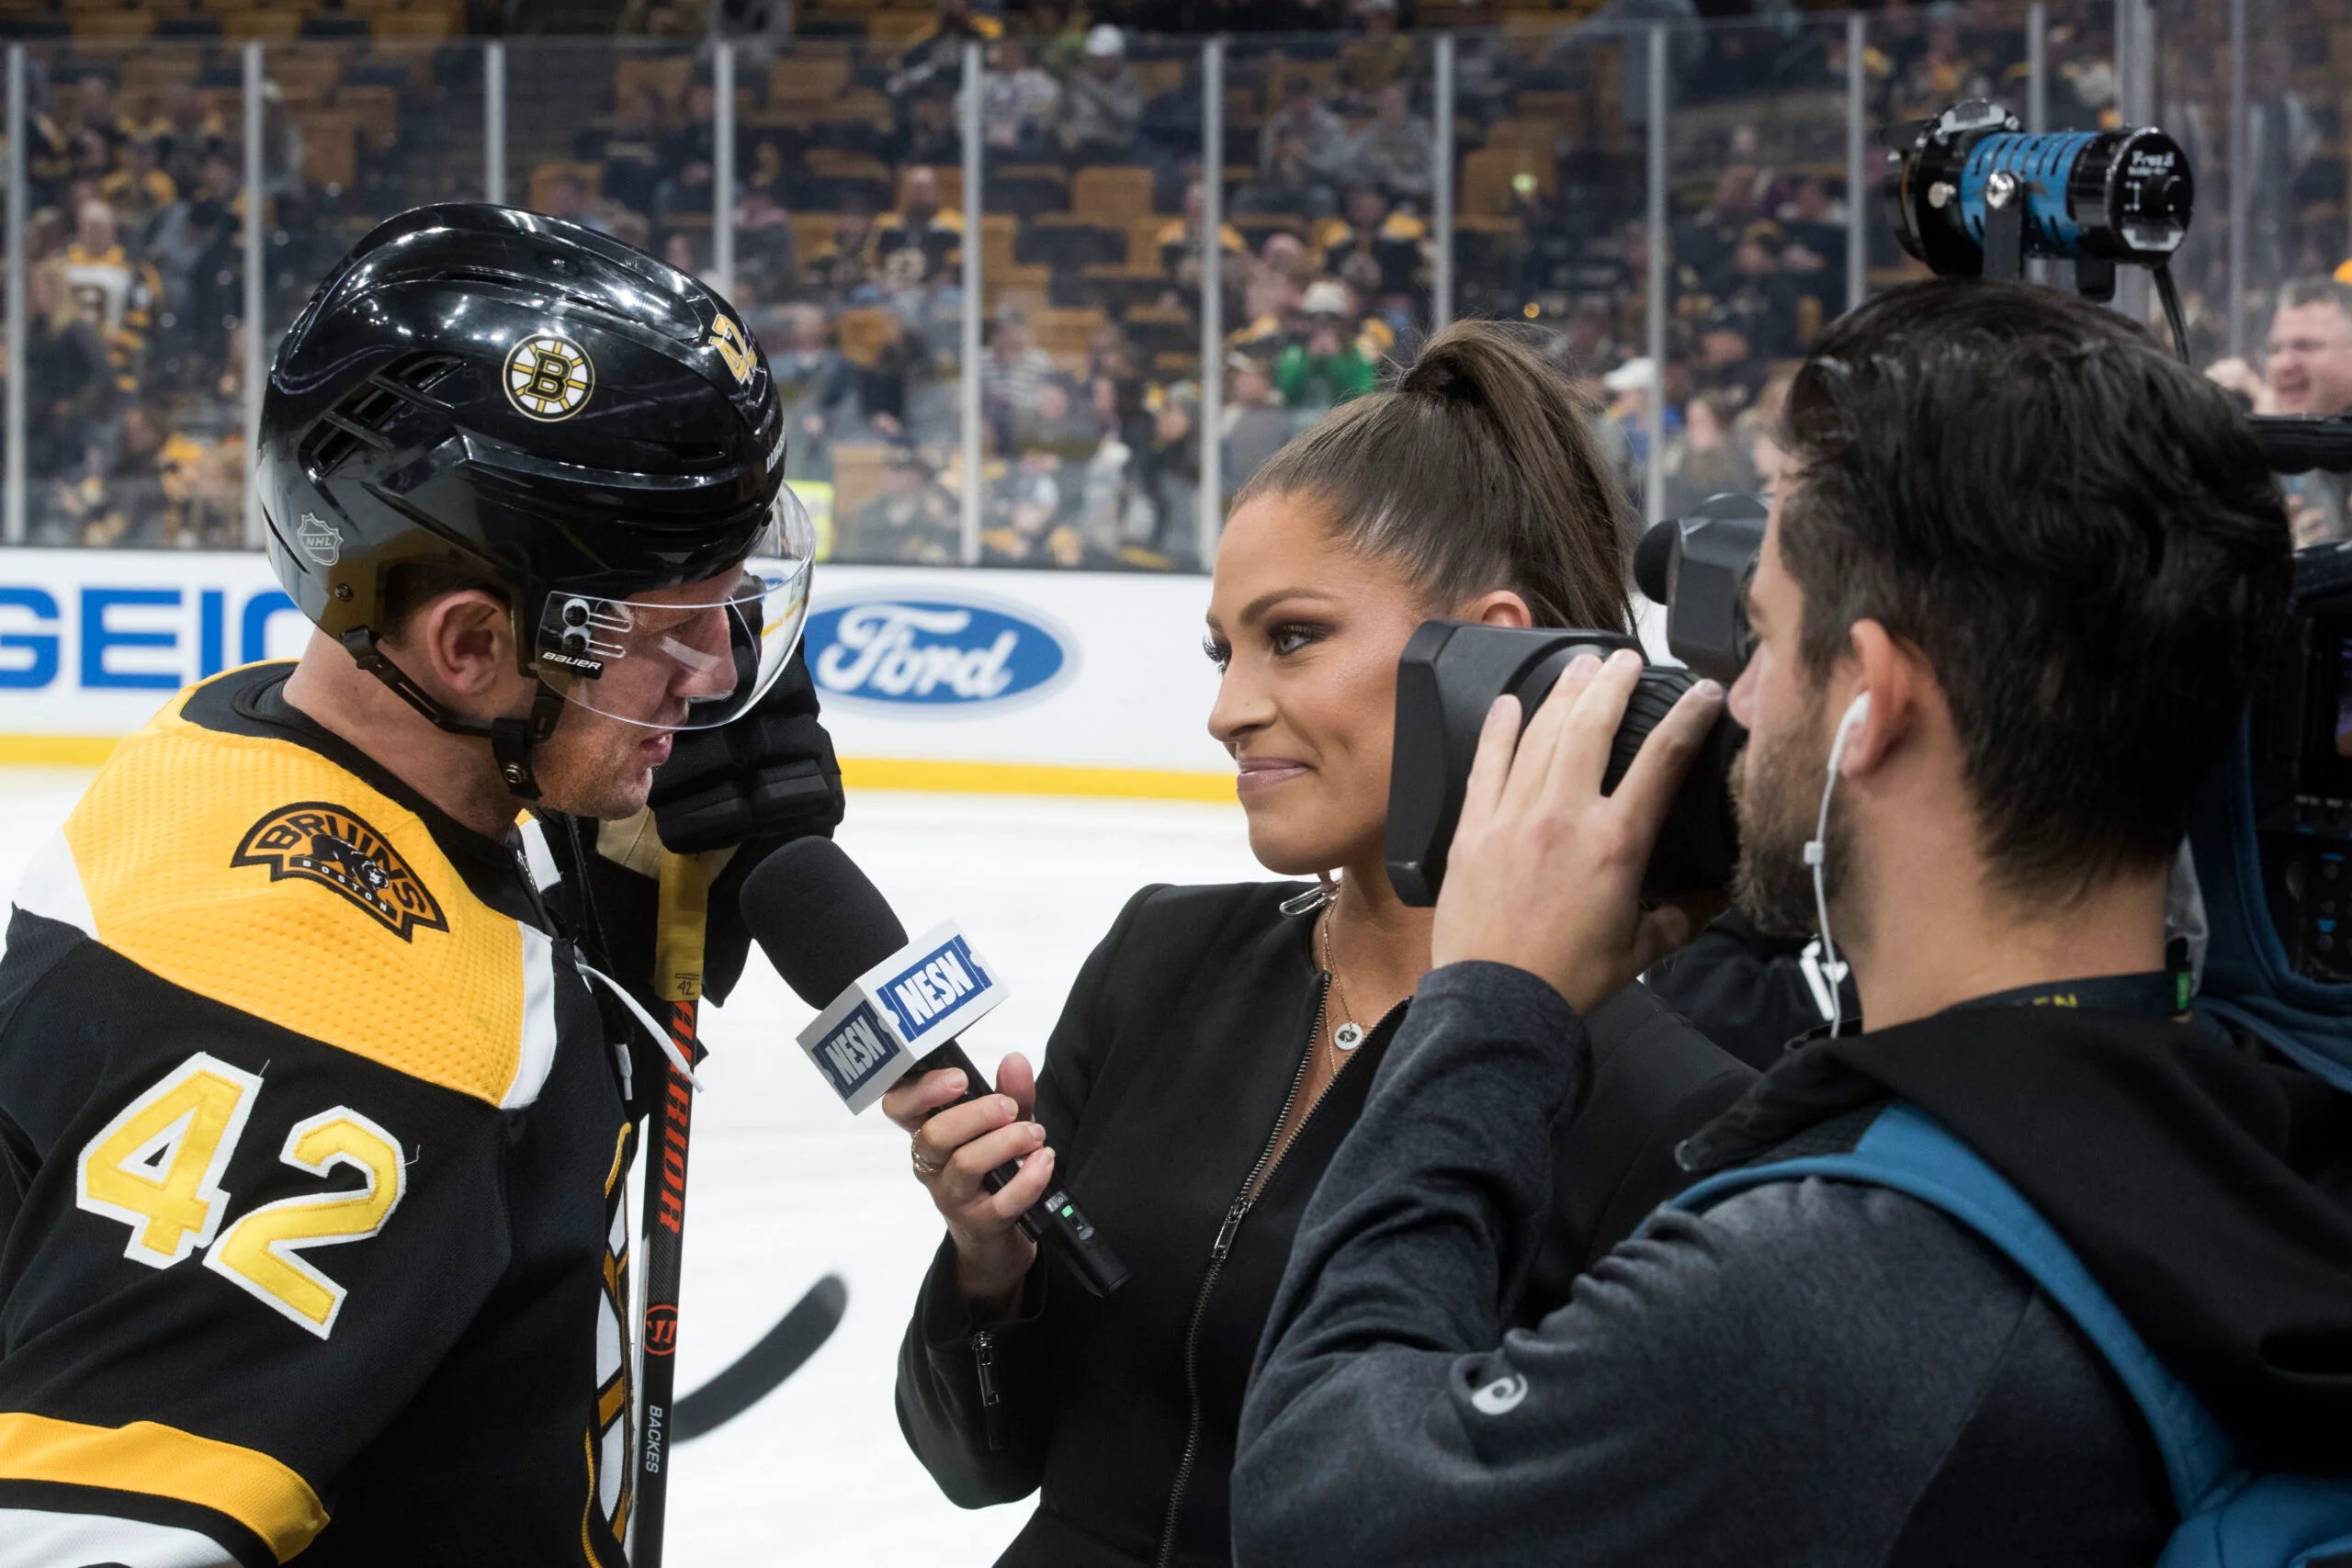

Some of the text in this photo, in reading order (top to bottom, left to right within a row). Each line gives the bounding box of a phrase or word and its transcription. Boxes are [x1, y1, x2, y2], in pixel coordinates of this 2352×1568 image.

[525, 348, 573, 403] B
[305, 536, 332, 546] NHL
[817, 604, 1018, 697] Ford
[255, 814, 426, 914] BRUINS
[302, 859, 387, 912] BOSTON
[676, 980, 695, 996] 42
[894, 950, 976, 1026] NESN
[824, 1015, 887, 1087] NESN
[75, 1052, 408, 1340] 42
[646, 1404, 662, 1473] BACKES
